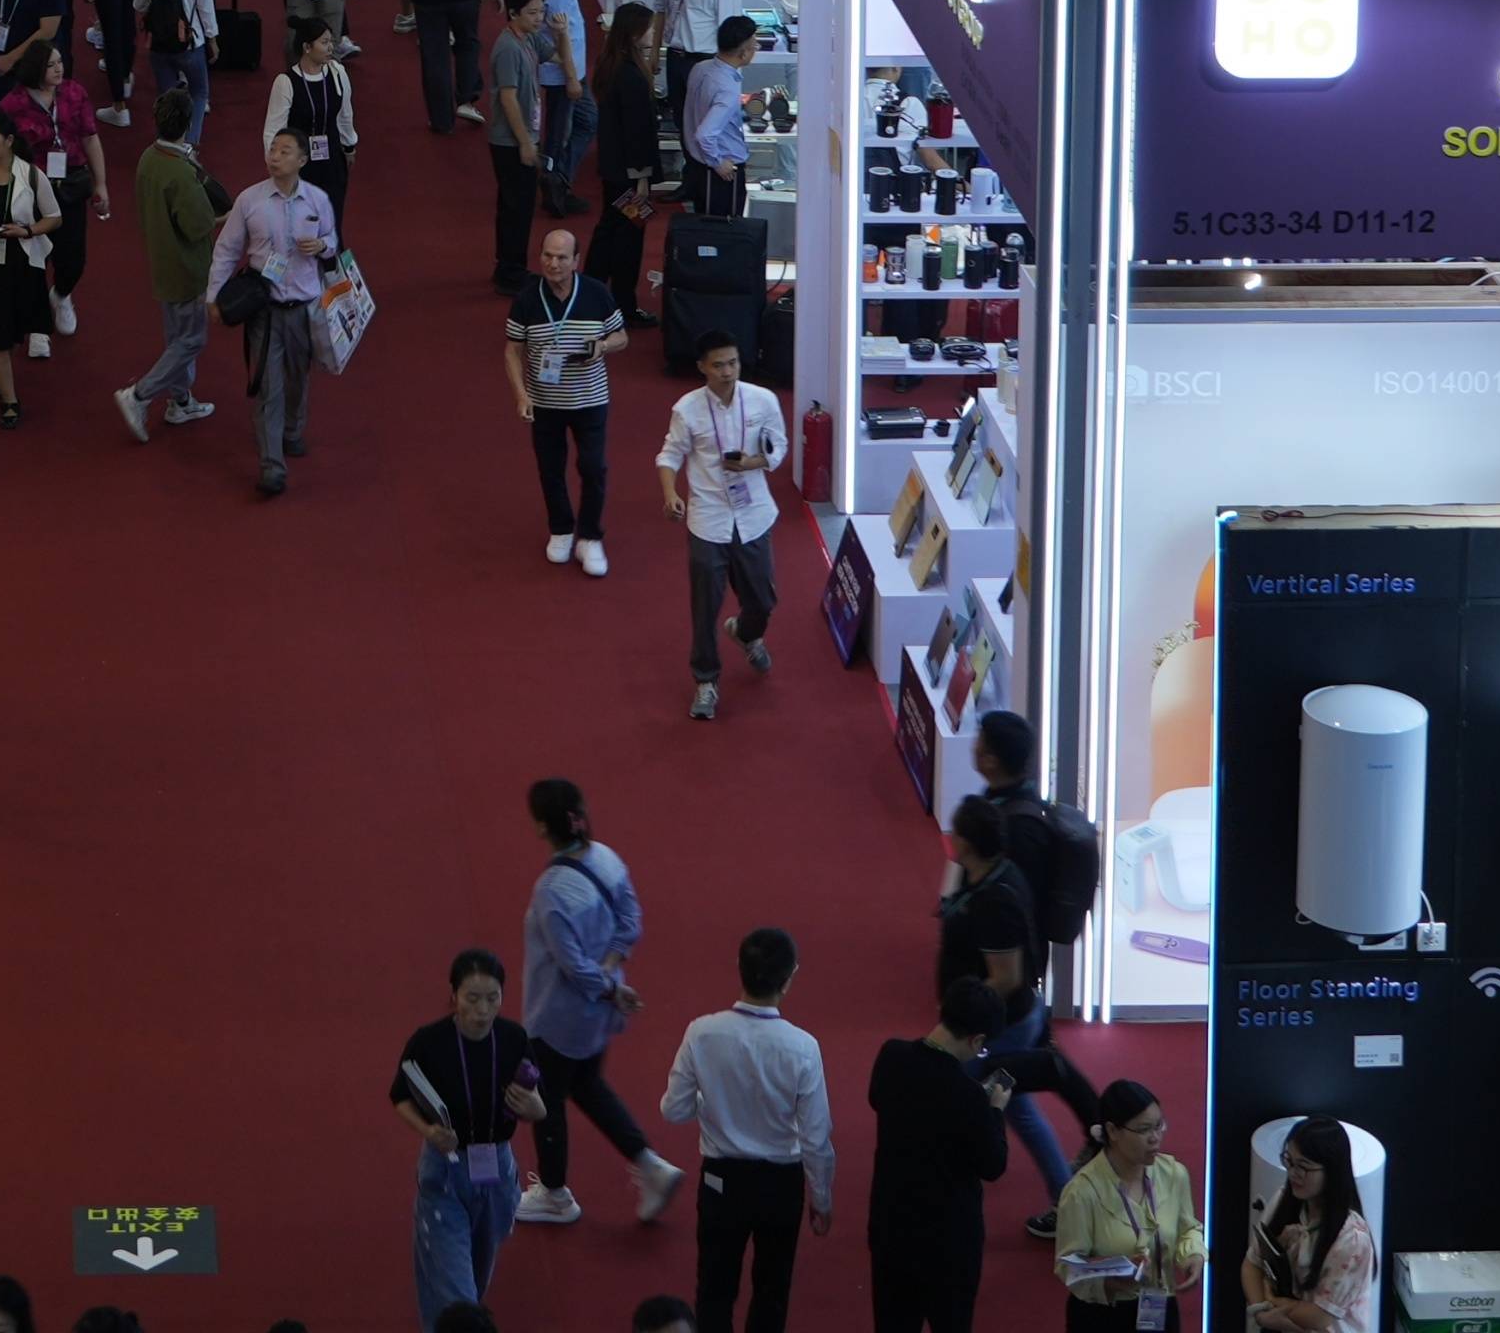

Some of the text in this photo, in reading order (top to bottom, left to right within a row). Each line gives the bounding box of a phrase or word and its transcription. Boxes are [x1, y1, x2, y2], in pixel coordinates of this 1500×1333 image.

[1172, 209, 1437, 238] 5.1C33-34 D11-12
[1152, 369, 1223, 397] BSCI
[1246, 571, 1417, 596] Vertical Series
[1237, 976, 1420, 1004] Floor Standing
[1236, 1005, 1315, 1029] Series
[87, 1206, 200, 1221] 安全出口
[105, 1221, 185, 1233] EXIT
